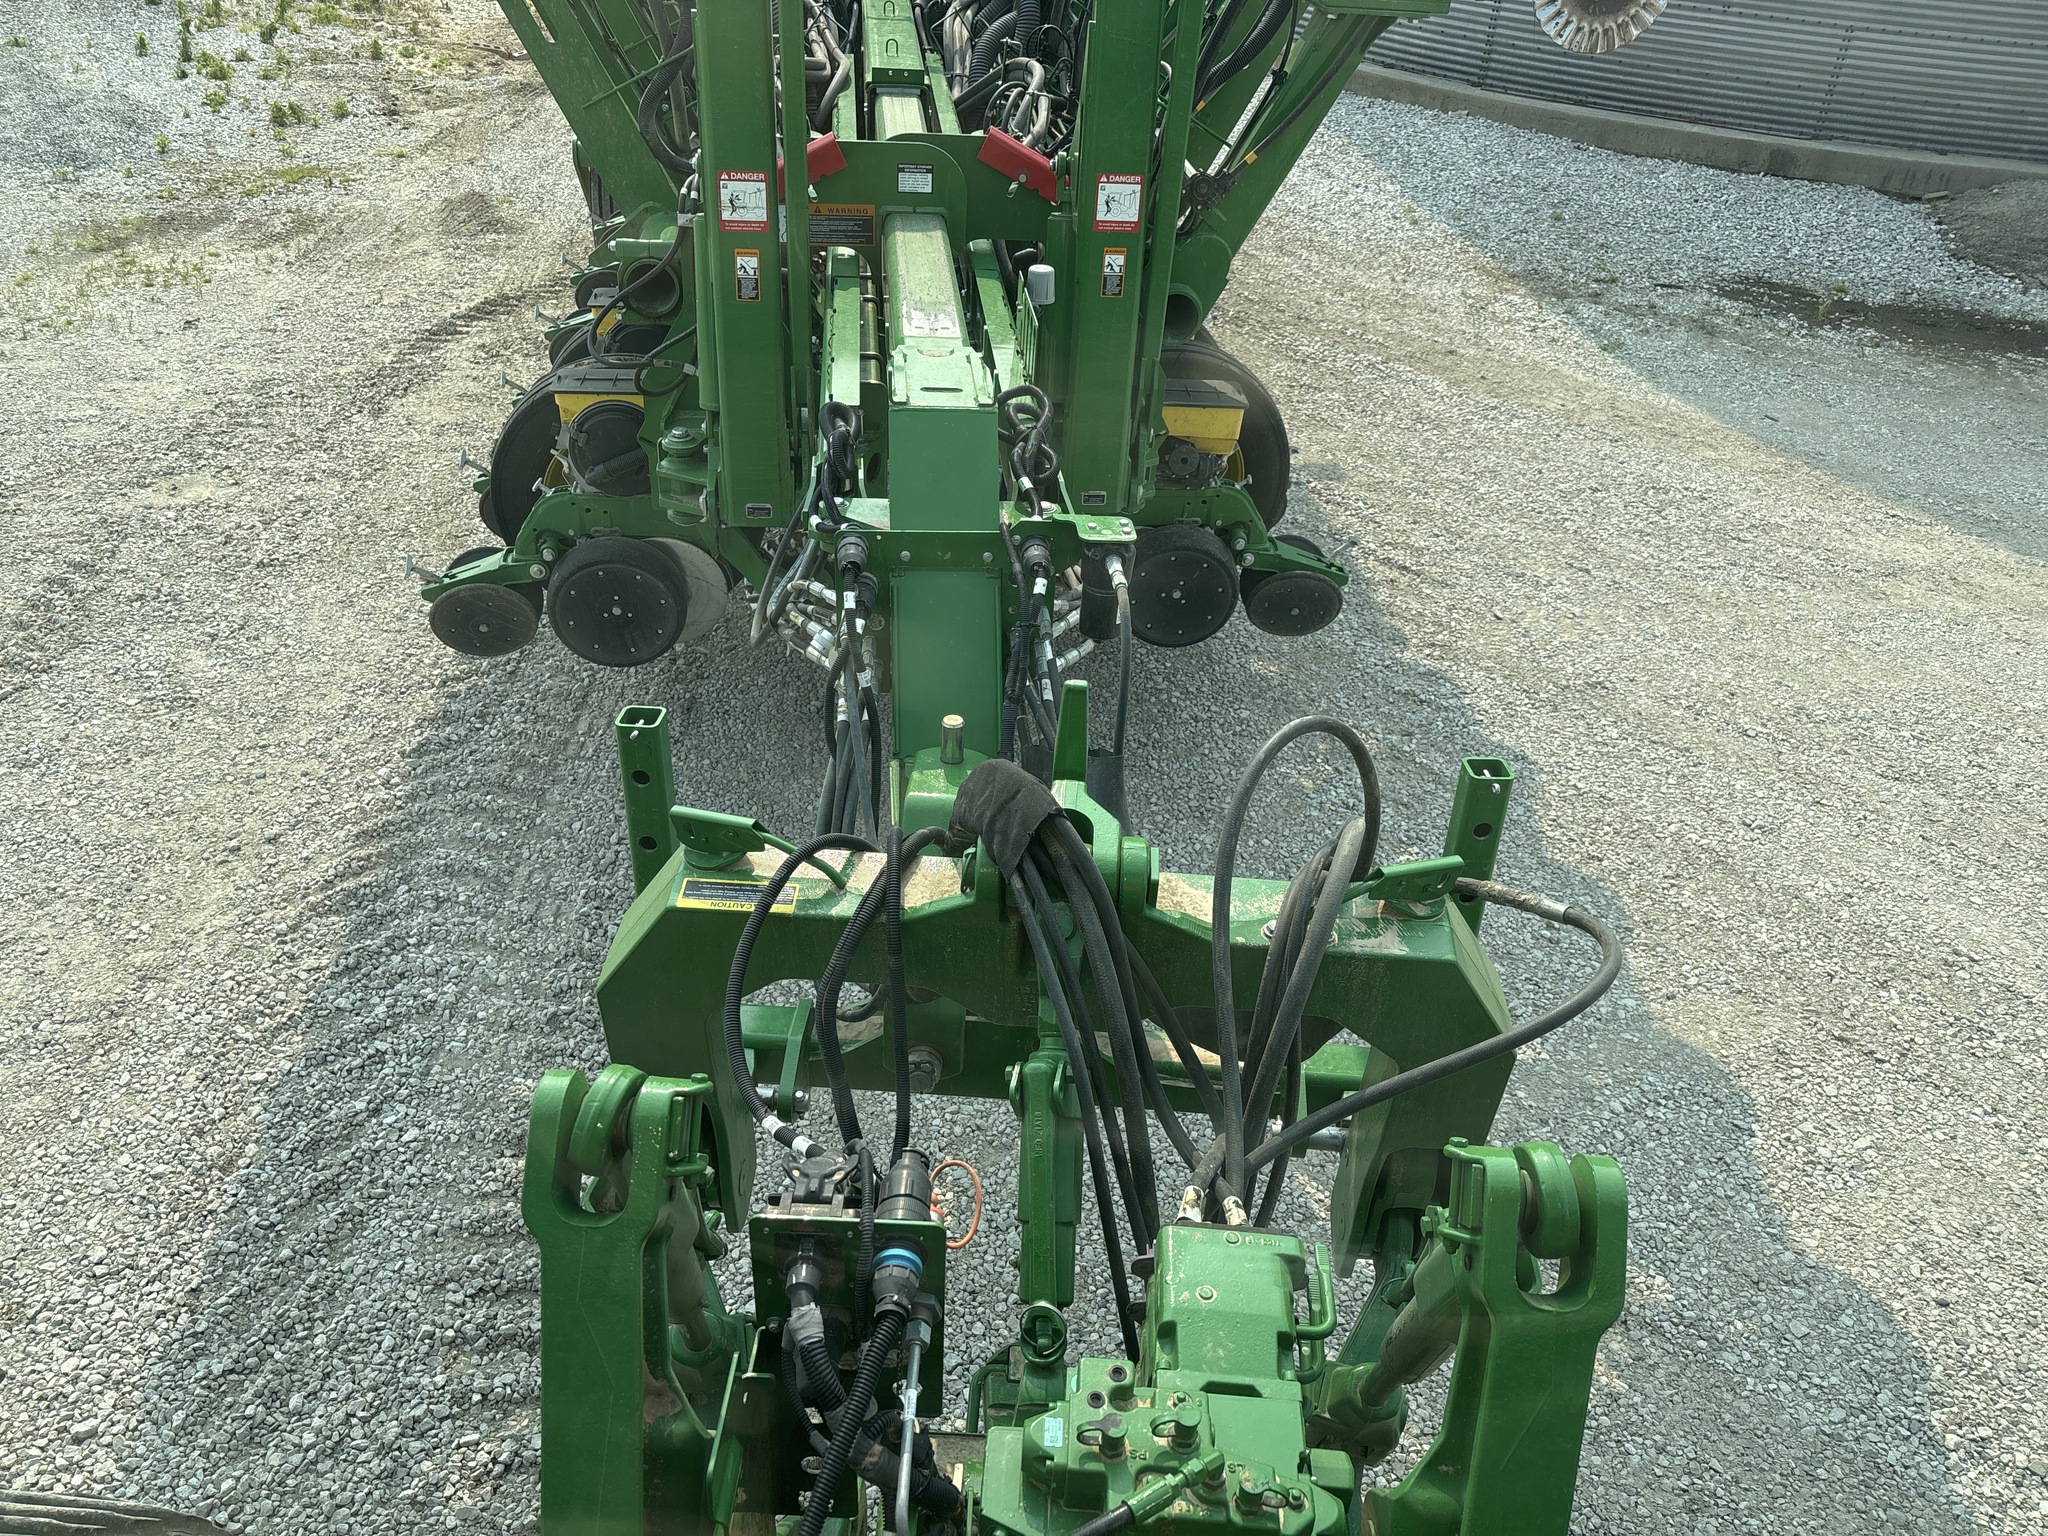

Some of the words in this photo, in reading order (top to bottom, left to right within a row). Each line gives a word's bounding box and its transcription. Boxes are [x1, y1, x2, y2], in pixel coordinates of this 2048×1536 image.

[731, 172, 765, 180] DANGER
[1109, 175, 1141, 183] DANGER
[710, 901, 753, 909] CAUTION
[1129, 1450, 1149, 1461] PS
